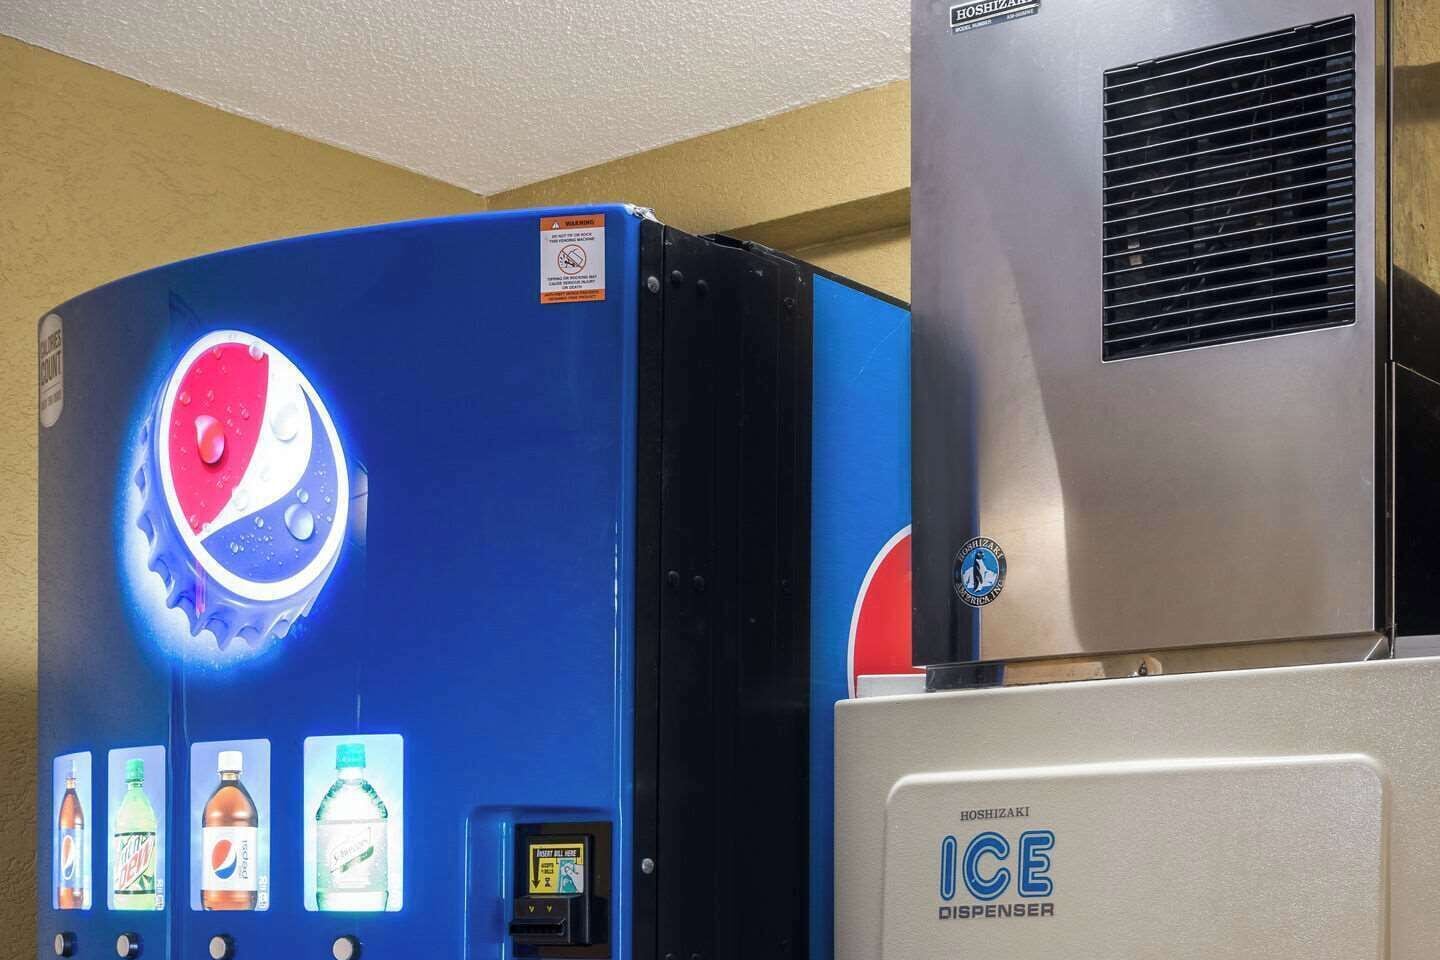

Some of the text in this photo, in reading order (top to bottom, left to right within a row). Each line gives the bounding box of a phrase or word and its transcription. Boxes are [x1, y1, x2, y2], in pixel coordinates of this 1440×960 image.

[960, 806, 1030, 820] HOSHIZAKI
[536, 849, 577, 858] INSERT BILL HERE
[940, 830, 1055, 901] ICE
[939, 903, 1054, 920] DISPENSER
